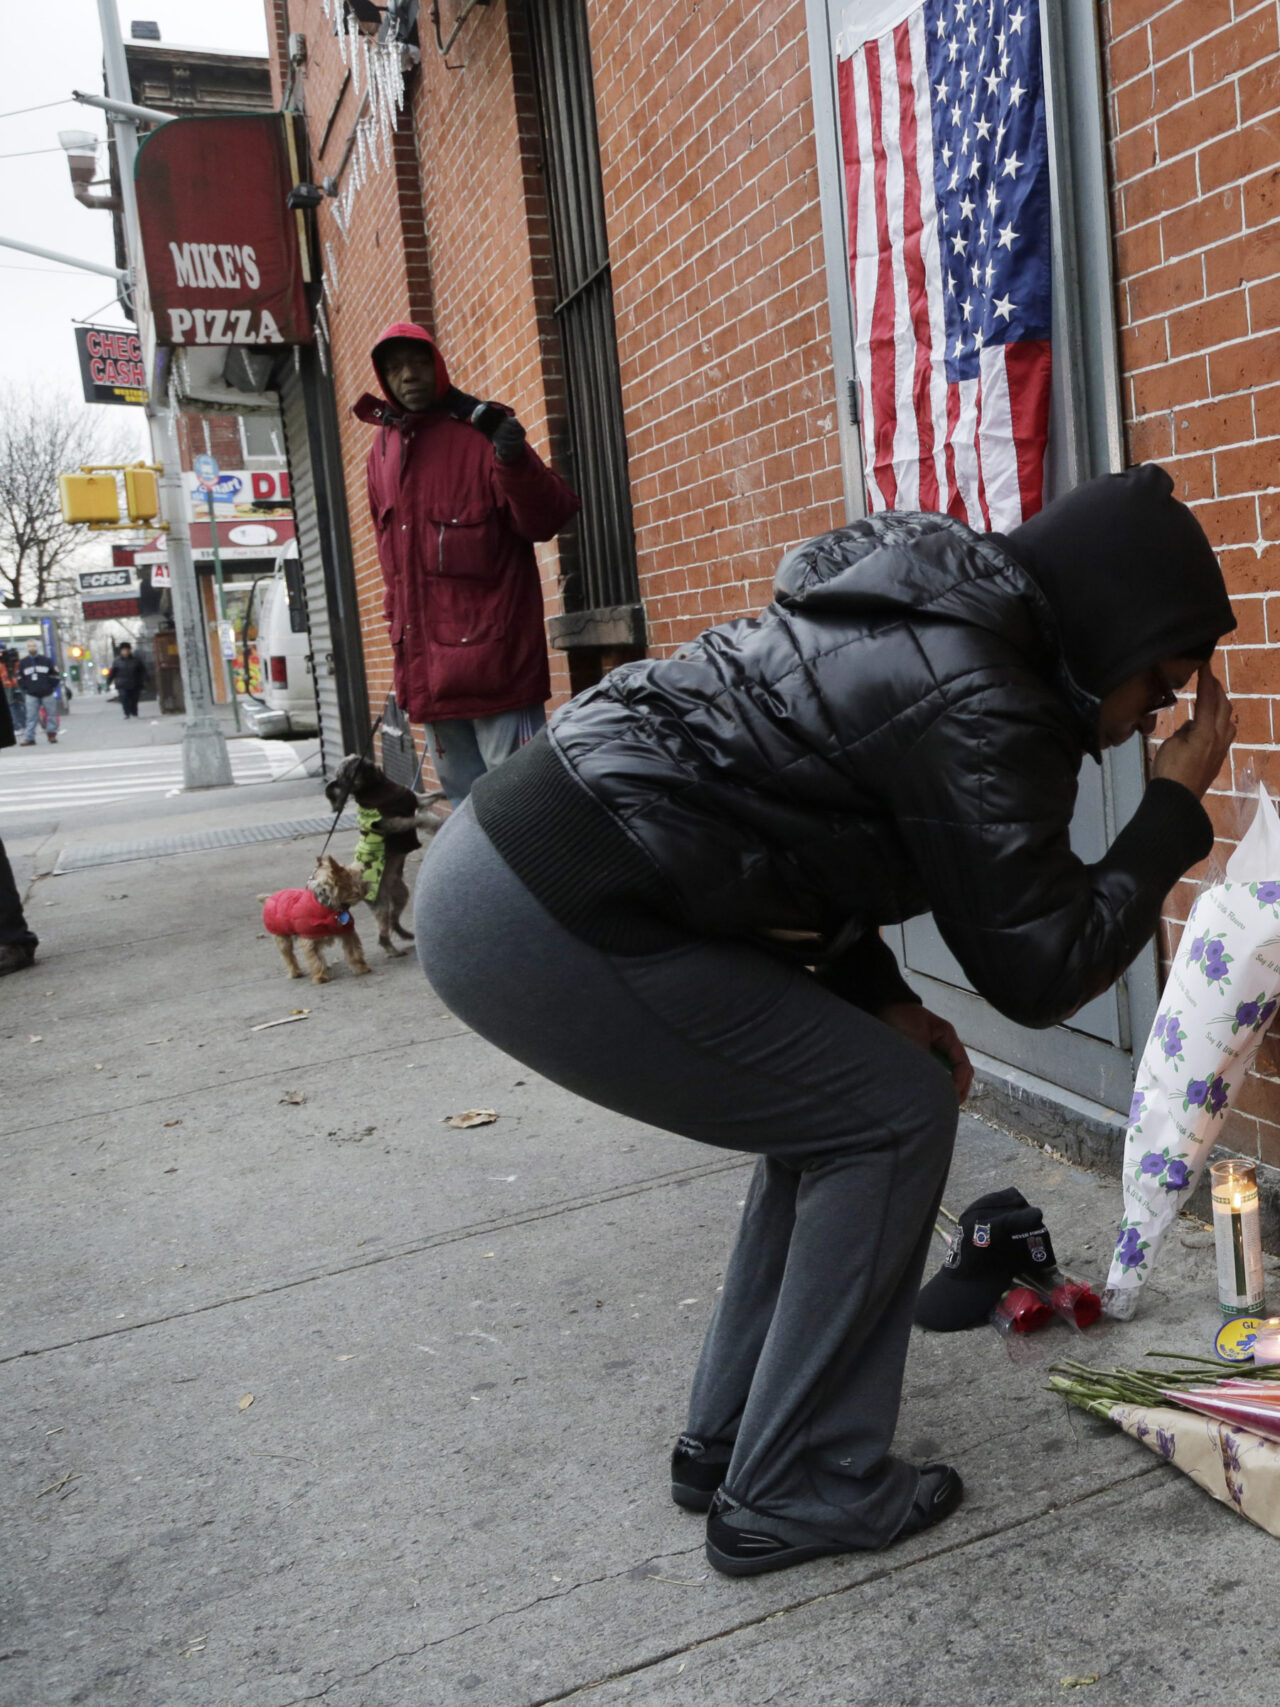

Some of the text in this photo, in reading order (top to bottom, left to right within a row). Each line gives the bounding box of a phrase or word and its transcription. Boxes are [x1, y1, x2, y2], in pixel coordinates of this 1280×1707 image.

[169, 241, 260, 290] MIKE'S
[167, 308, 285, 344] PIZZA
[89, 358, 146, 387] CASH
